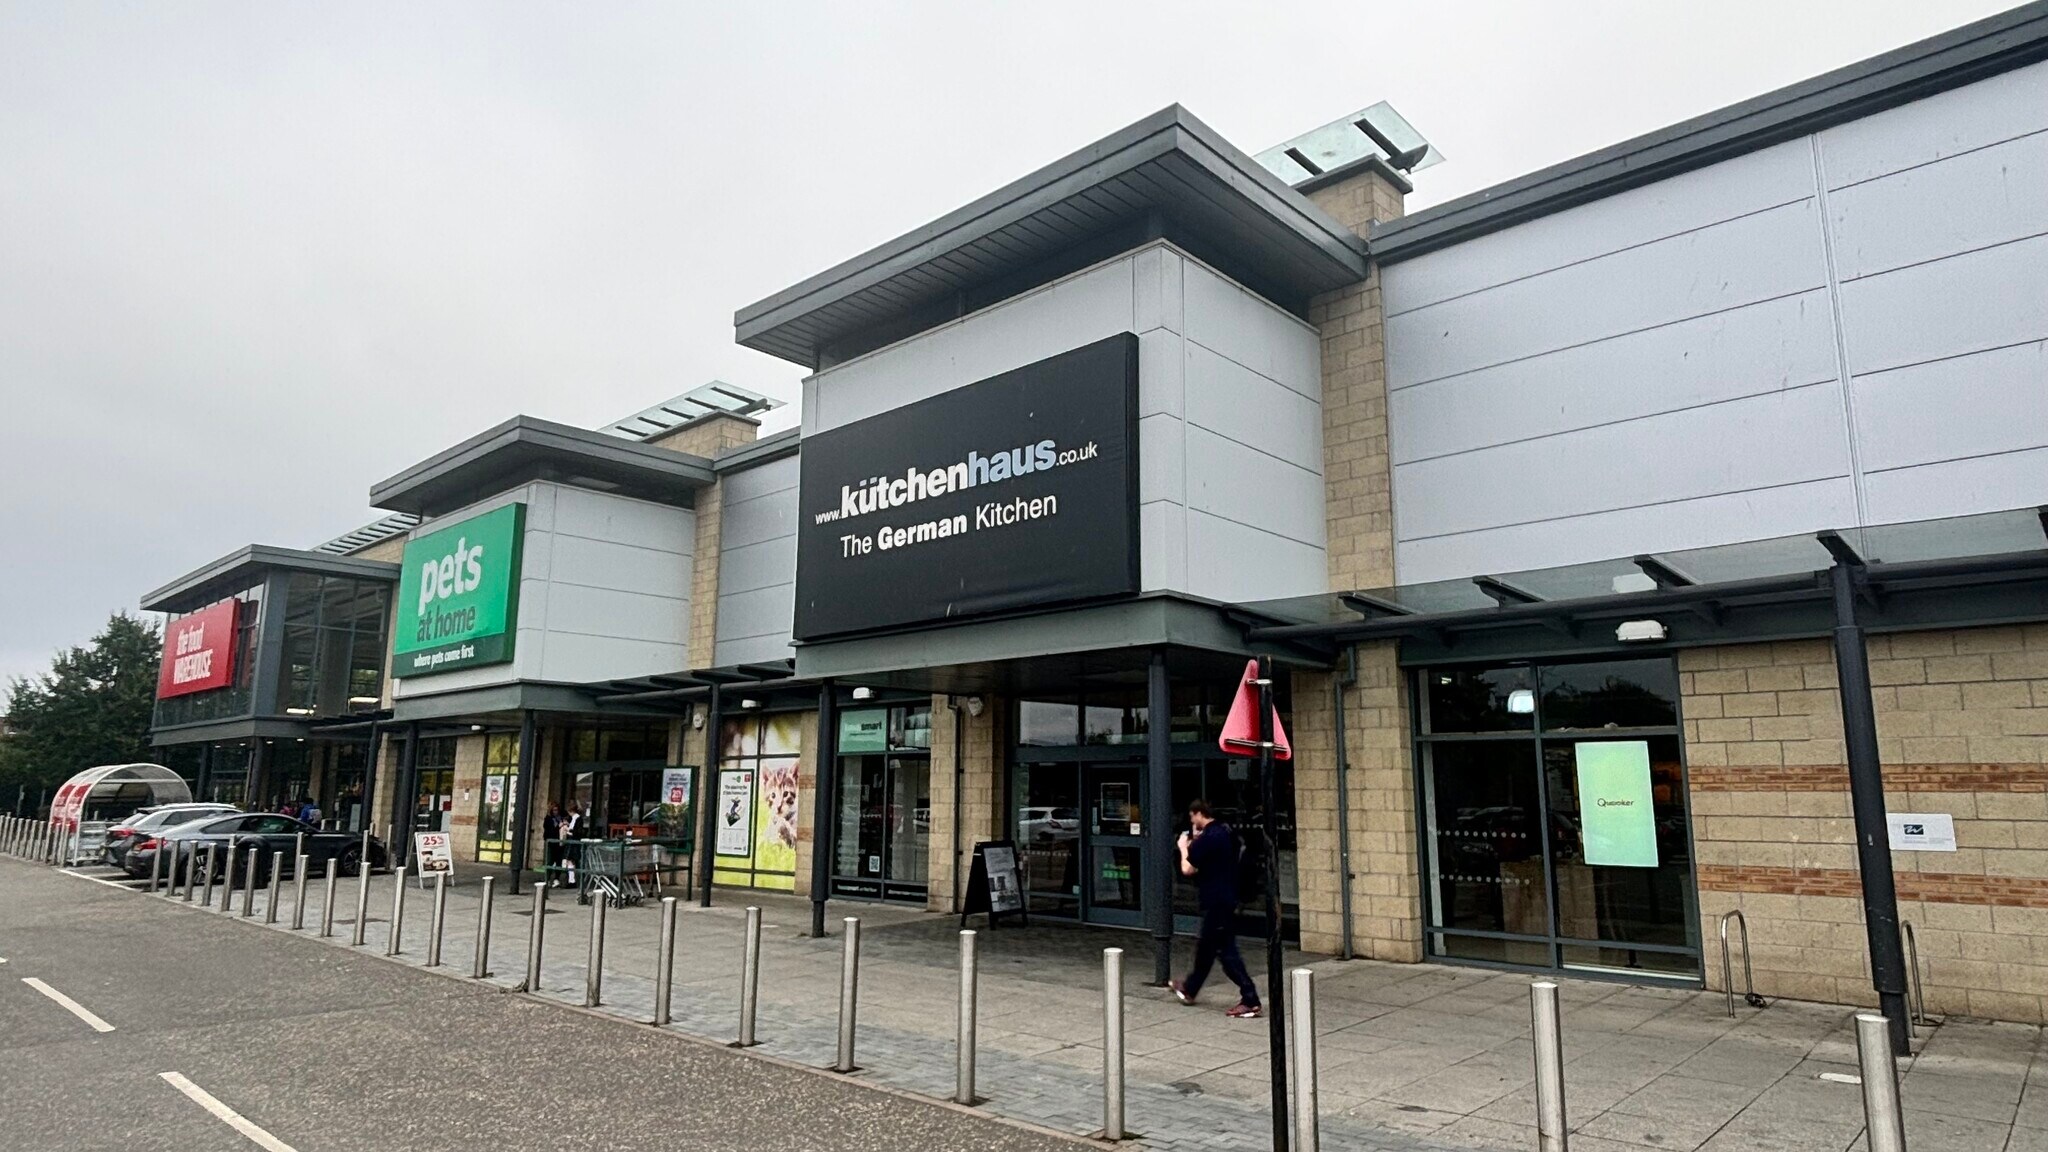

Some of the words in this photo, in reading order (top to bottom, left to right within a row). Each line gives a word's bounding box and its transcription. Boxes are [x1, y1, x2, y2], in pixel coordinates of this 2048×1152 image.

[840, 534, 872, 558] The
[877, 513, 967, 550] German
[976, 494, 1057, 530] Kitchen
[418, 536, 483, 616] pets
[417, 609, 433, 643] at
[434, 605, 476, 640] home
[414, 653, 431, 668] where
[431, 651, 444, 670] pets
[444, 649, 460, 662] come
[461, 644, 475, 659] first
